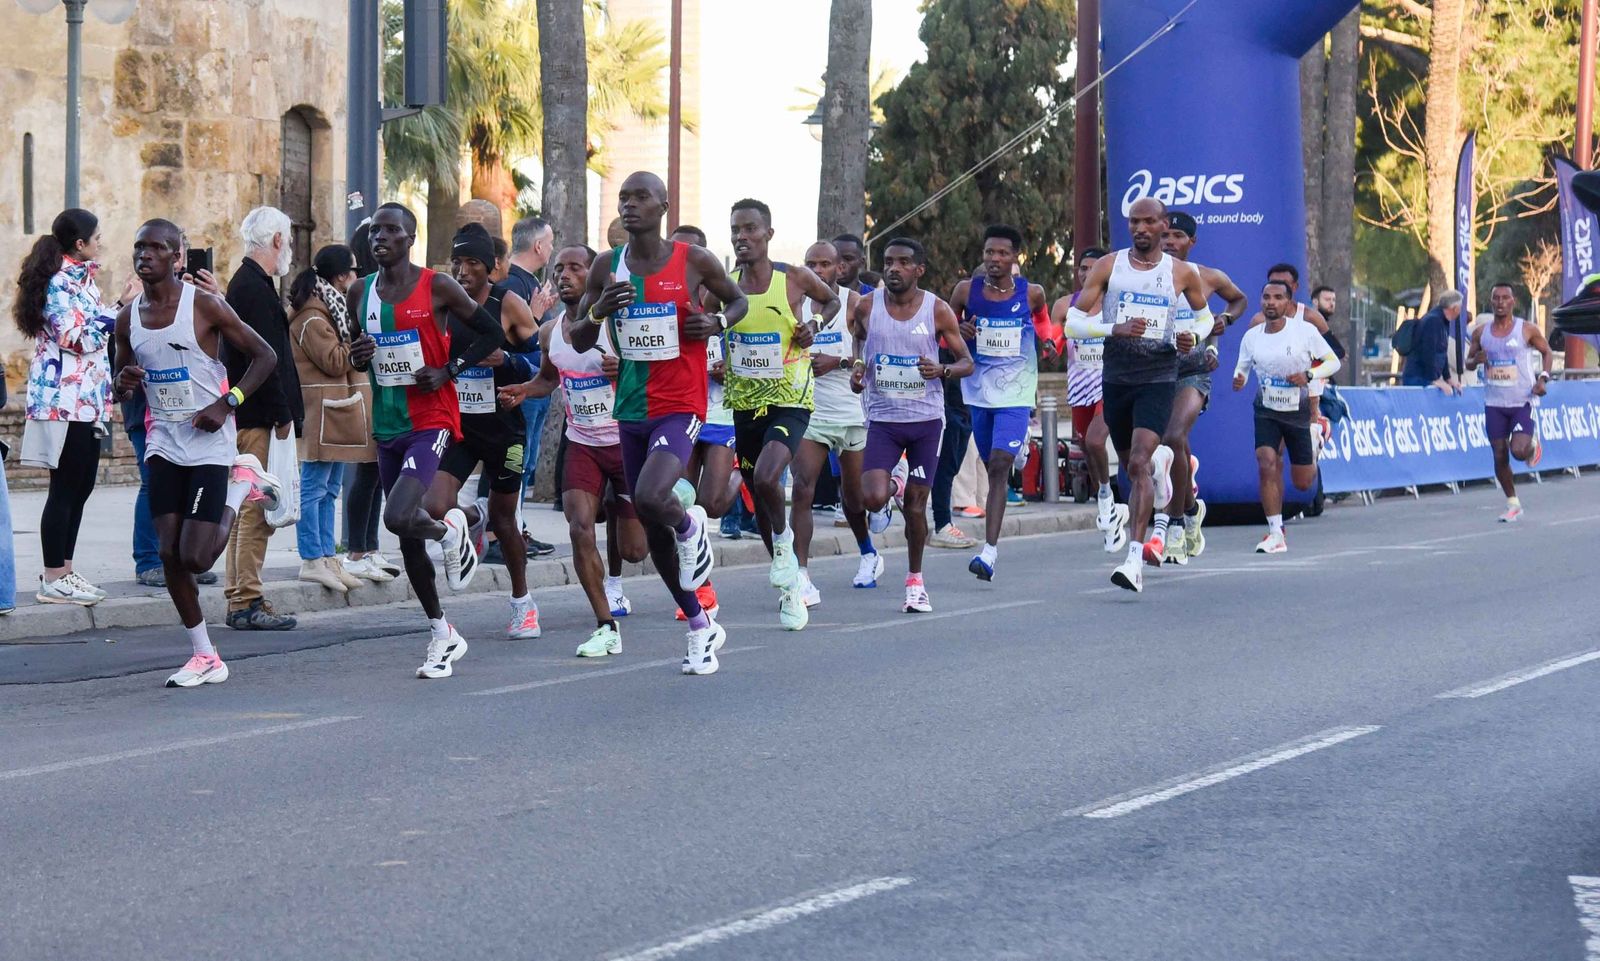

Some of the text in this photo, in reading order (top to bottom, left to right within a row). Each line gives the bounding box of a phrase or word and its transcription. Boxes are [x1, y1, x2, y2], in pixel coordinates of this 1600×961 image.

[1154, 173, 1244, 206] asics
[1207, 212, 1239, 224] sound
[1240, 211, 1264, 225] body
[1136, 295, 1164, 304] ZURICH
[633, 306, 669, 316] ZURICH
[640, 324, 650, 332] 42
[379, 333, 411, 344] ZURICH
[628, 335, 665, 348] PACER
[744, 335, 774, 343] ZURICH
[986, 339, 1010, 348] HAILU
[387, 351, 396, 359] 41
[1080, 354, 1103, 362] GOITO
[741, 356, 769, 368] ADISU
[892, 357, 920, 365] ZURICH
[378, 361, 412, 374] PACER
[152, 371, 182, 380] ZURICH
[464, 382, 470, 390] 2
[574, 379, 604, 389] ZURICH
[876, 380, 926, 389] GEBRETSADIK
[159, 387, 168, 395] 57
[457, 391, 484, 402] ITATA
[574, 402, 608, 416] DEGEFA
